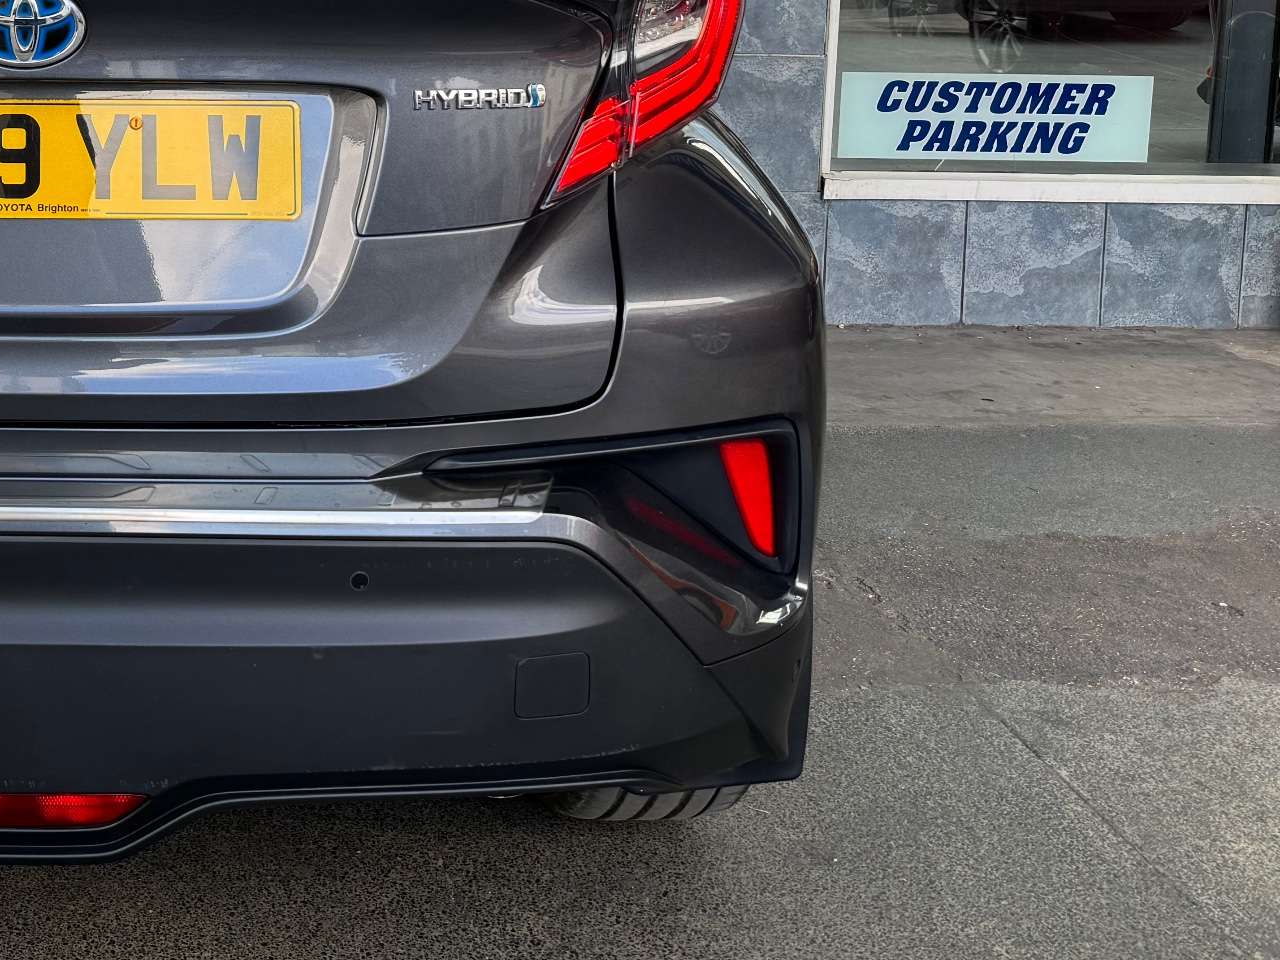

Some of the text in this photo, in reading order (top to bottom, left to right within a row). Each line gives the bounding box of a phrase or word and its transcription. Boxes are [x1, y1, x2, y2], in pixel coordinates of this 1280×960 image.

[413, 88, 529, 110] HYBRID
[876, 80, 1116, 116] CUSTOMER
[896, 119, 1091, 155] PARKING
[75, 114, 262, 200] YLW
[37, 203, 79, 214] Brighton
